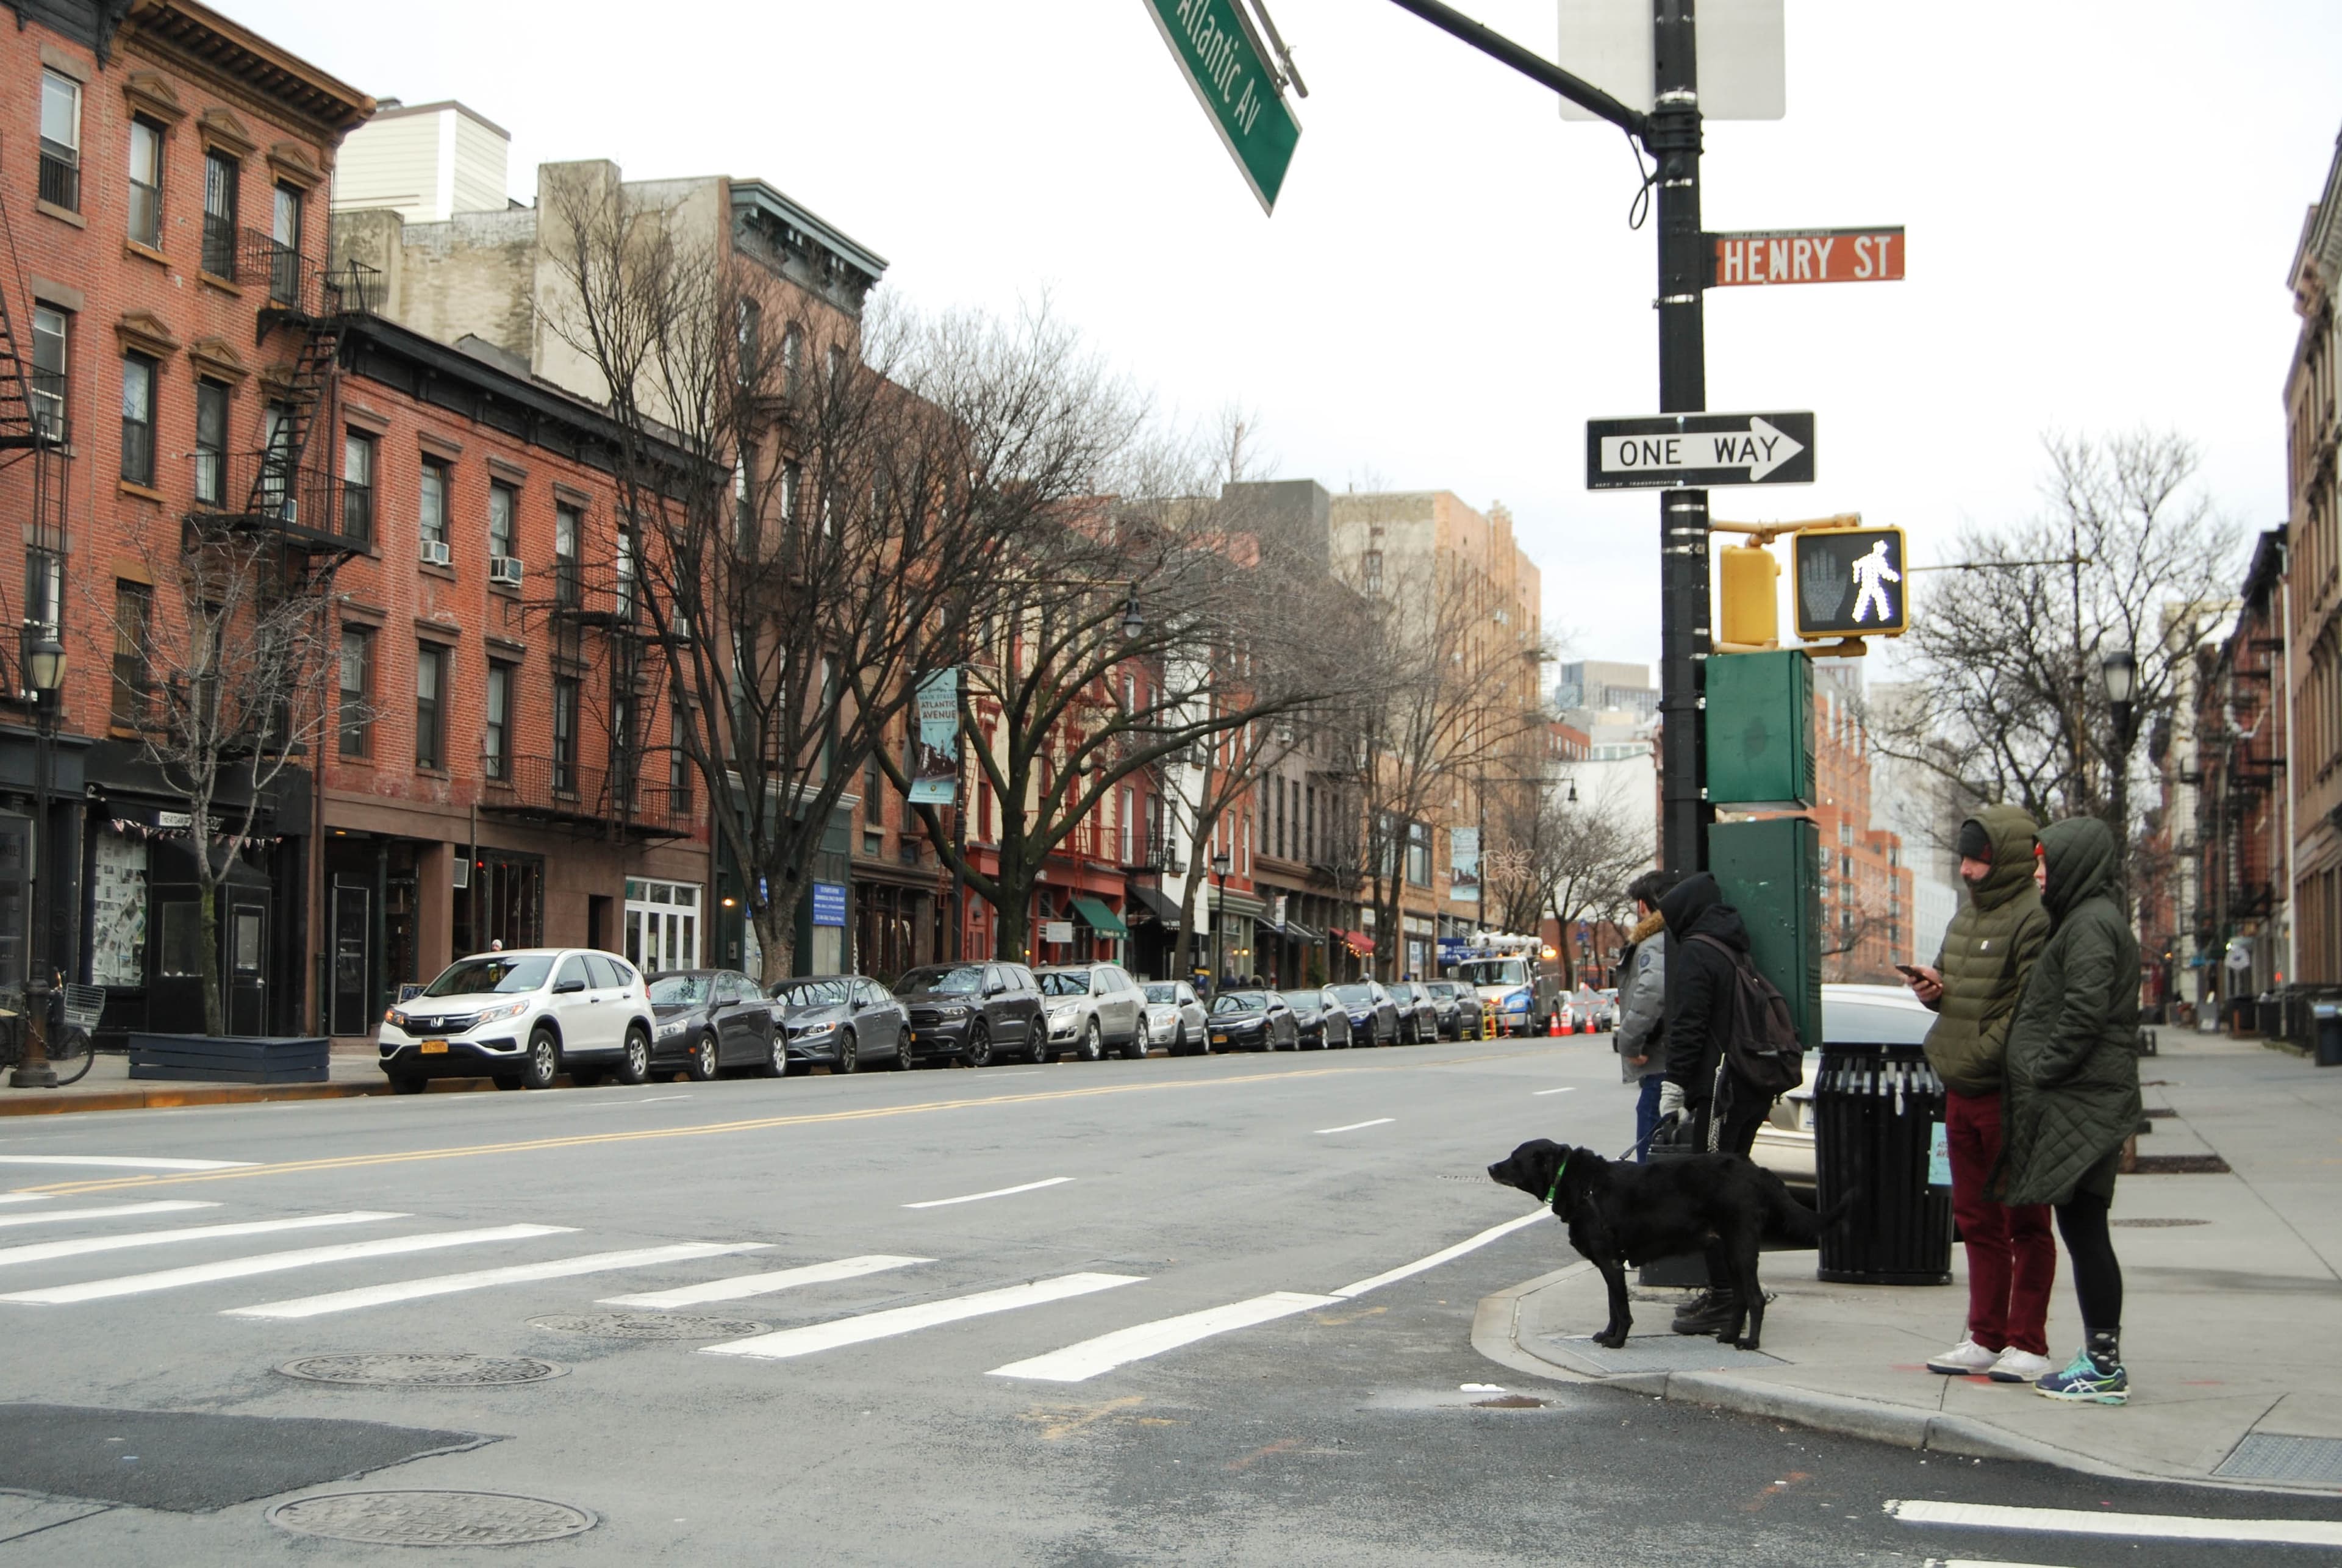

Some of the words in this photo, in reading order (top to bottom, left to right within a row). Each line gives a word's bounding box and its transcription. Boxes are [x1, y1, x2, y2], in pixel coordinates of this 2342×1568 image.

[1176, 0, 1241, 102] Atlantic
[1234, 77, 1261, 135] Av
[1724, 238, 1833, 282] HENRY
[1854, 236, 1891, 278] ST
[1619, 439, 1681, 467] ONE
[1714, 435, 1780, 463] WAY
[923, 710, 956, 719] AVENUE
